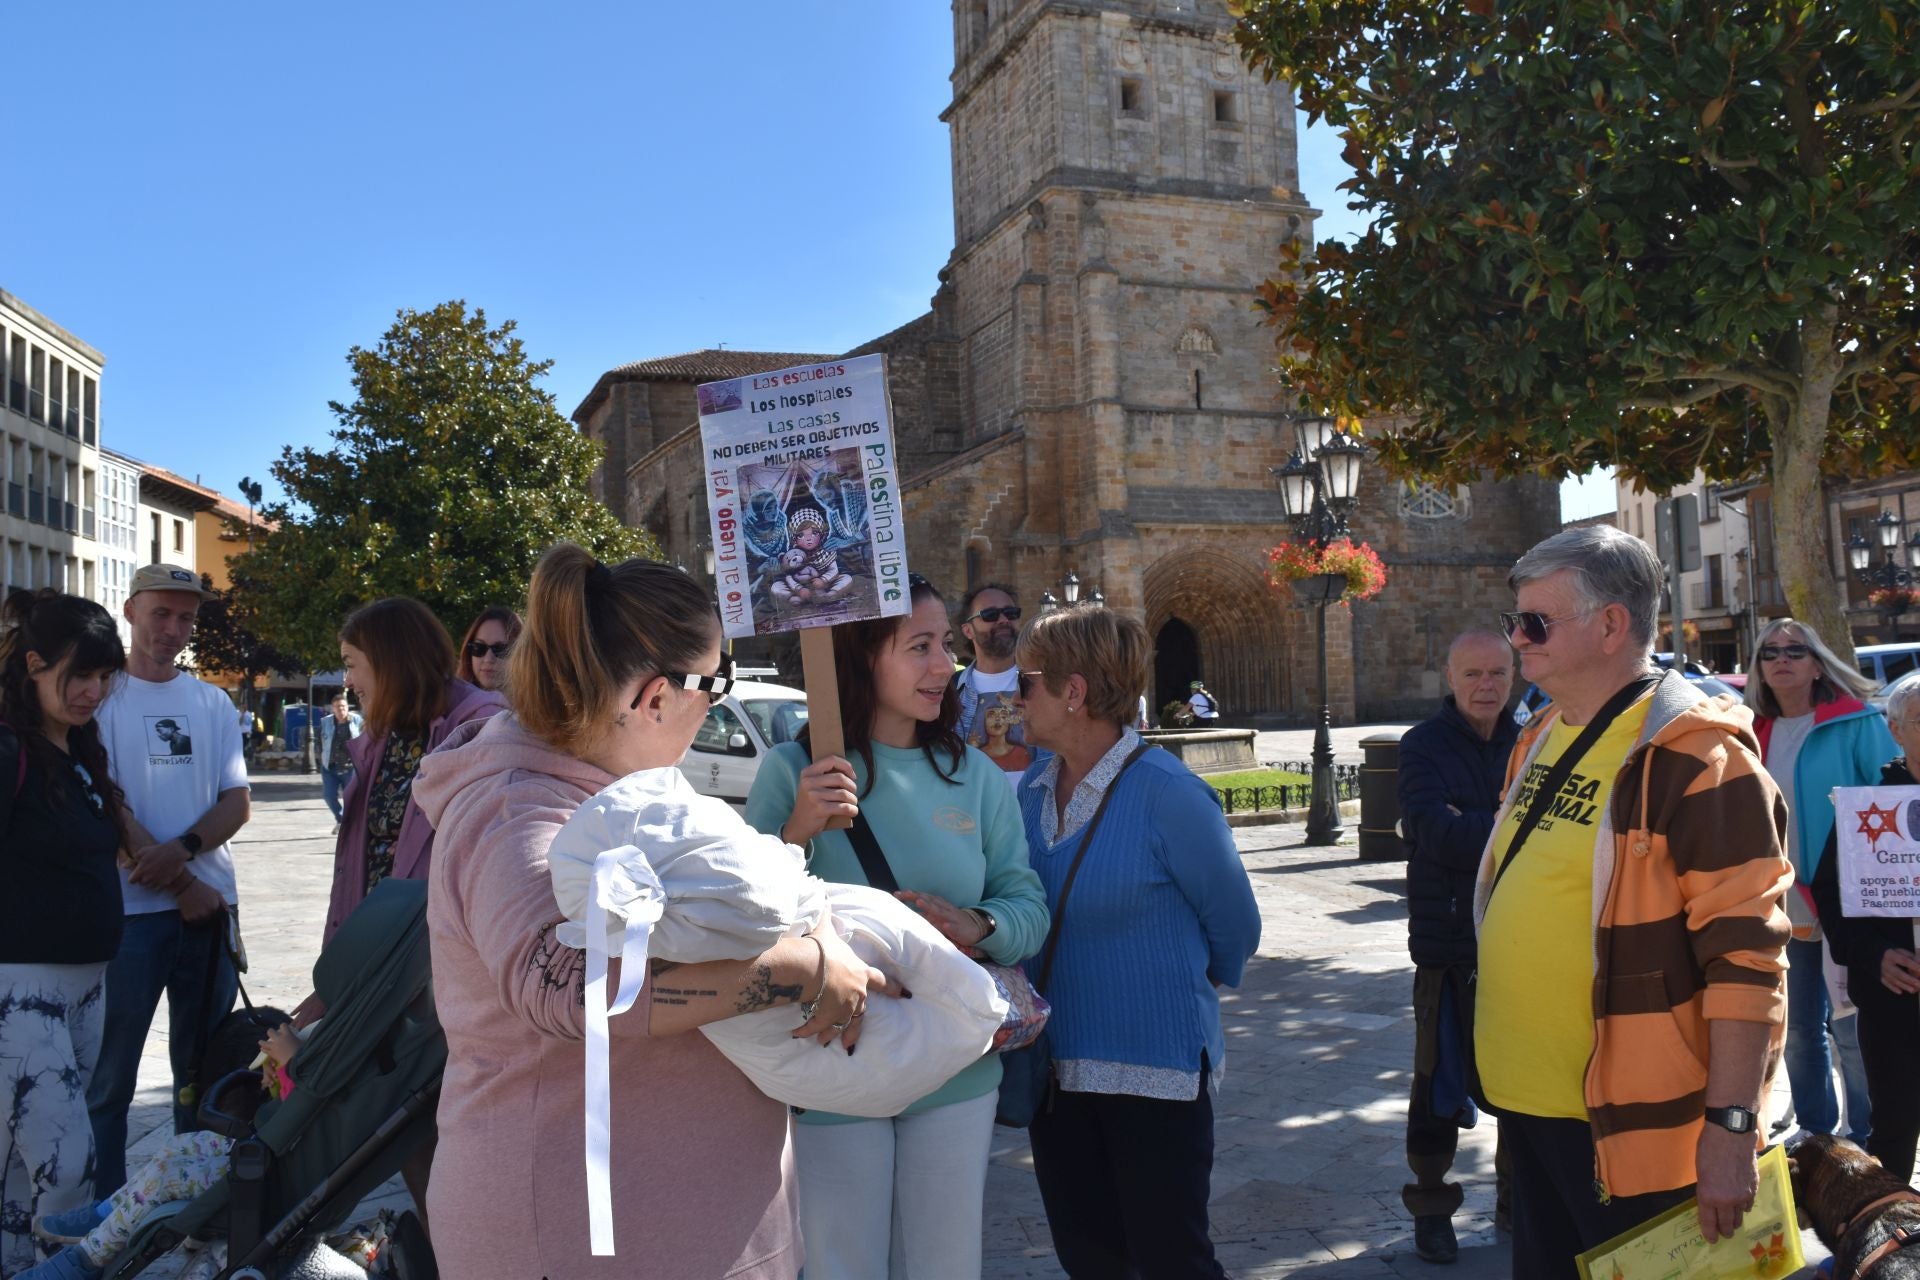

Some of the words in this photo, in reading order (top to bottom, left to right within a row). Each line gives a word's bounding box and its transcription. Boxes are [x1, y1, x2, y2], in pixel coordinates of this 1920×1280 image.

[753, 376, 779, 390] Las
[783, 364, 845, 385] escuelas
[751, 399, 776, 414] Los
[780, 386, 853, 407] hospitales
[768, 419, 794, 434] Las
[798, 411, 841, 429] casas
[713, 446, 732, 460] NO
[735, 439, 778, 456] DEBEN
[781, 434, 806, 448] SER
[809, 421, 880, 443] OBJETIVOS
[763, 446, 832, 467] MILITARES
[710, 469, 734, 499] ya!
[865, 443, 894, 543] Palestina
[717, 502, 737, 562] fuego,
[721, 566, 740, 585] al
[879, 550, 902, 602] libre
[726, 590, 745, 625] Alto
[1860, 877, 1896, 887] apoya
[1899, 876, 1910, 885] el
[1861, 888, 1879, 897] del
[1882, 887, 1920, 898] pueblo
[1862, 899, 1914, 908] Pasemos
